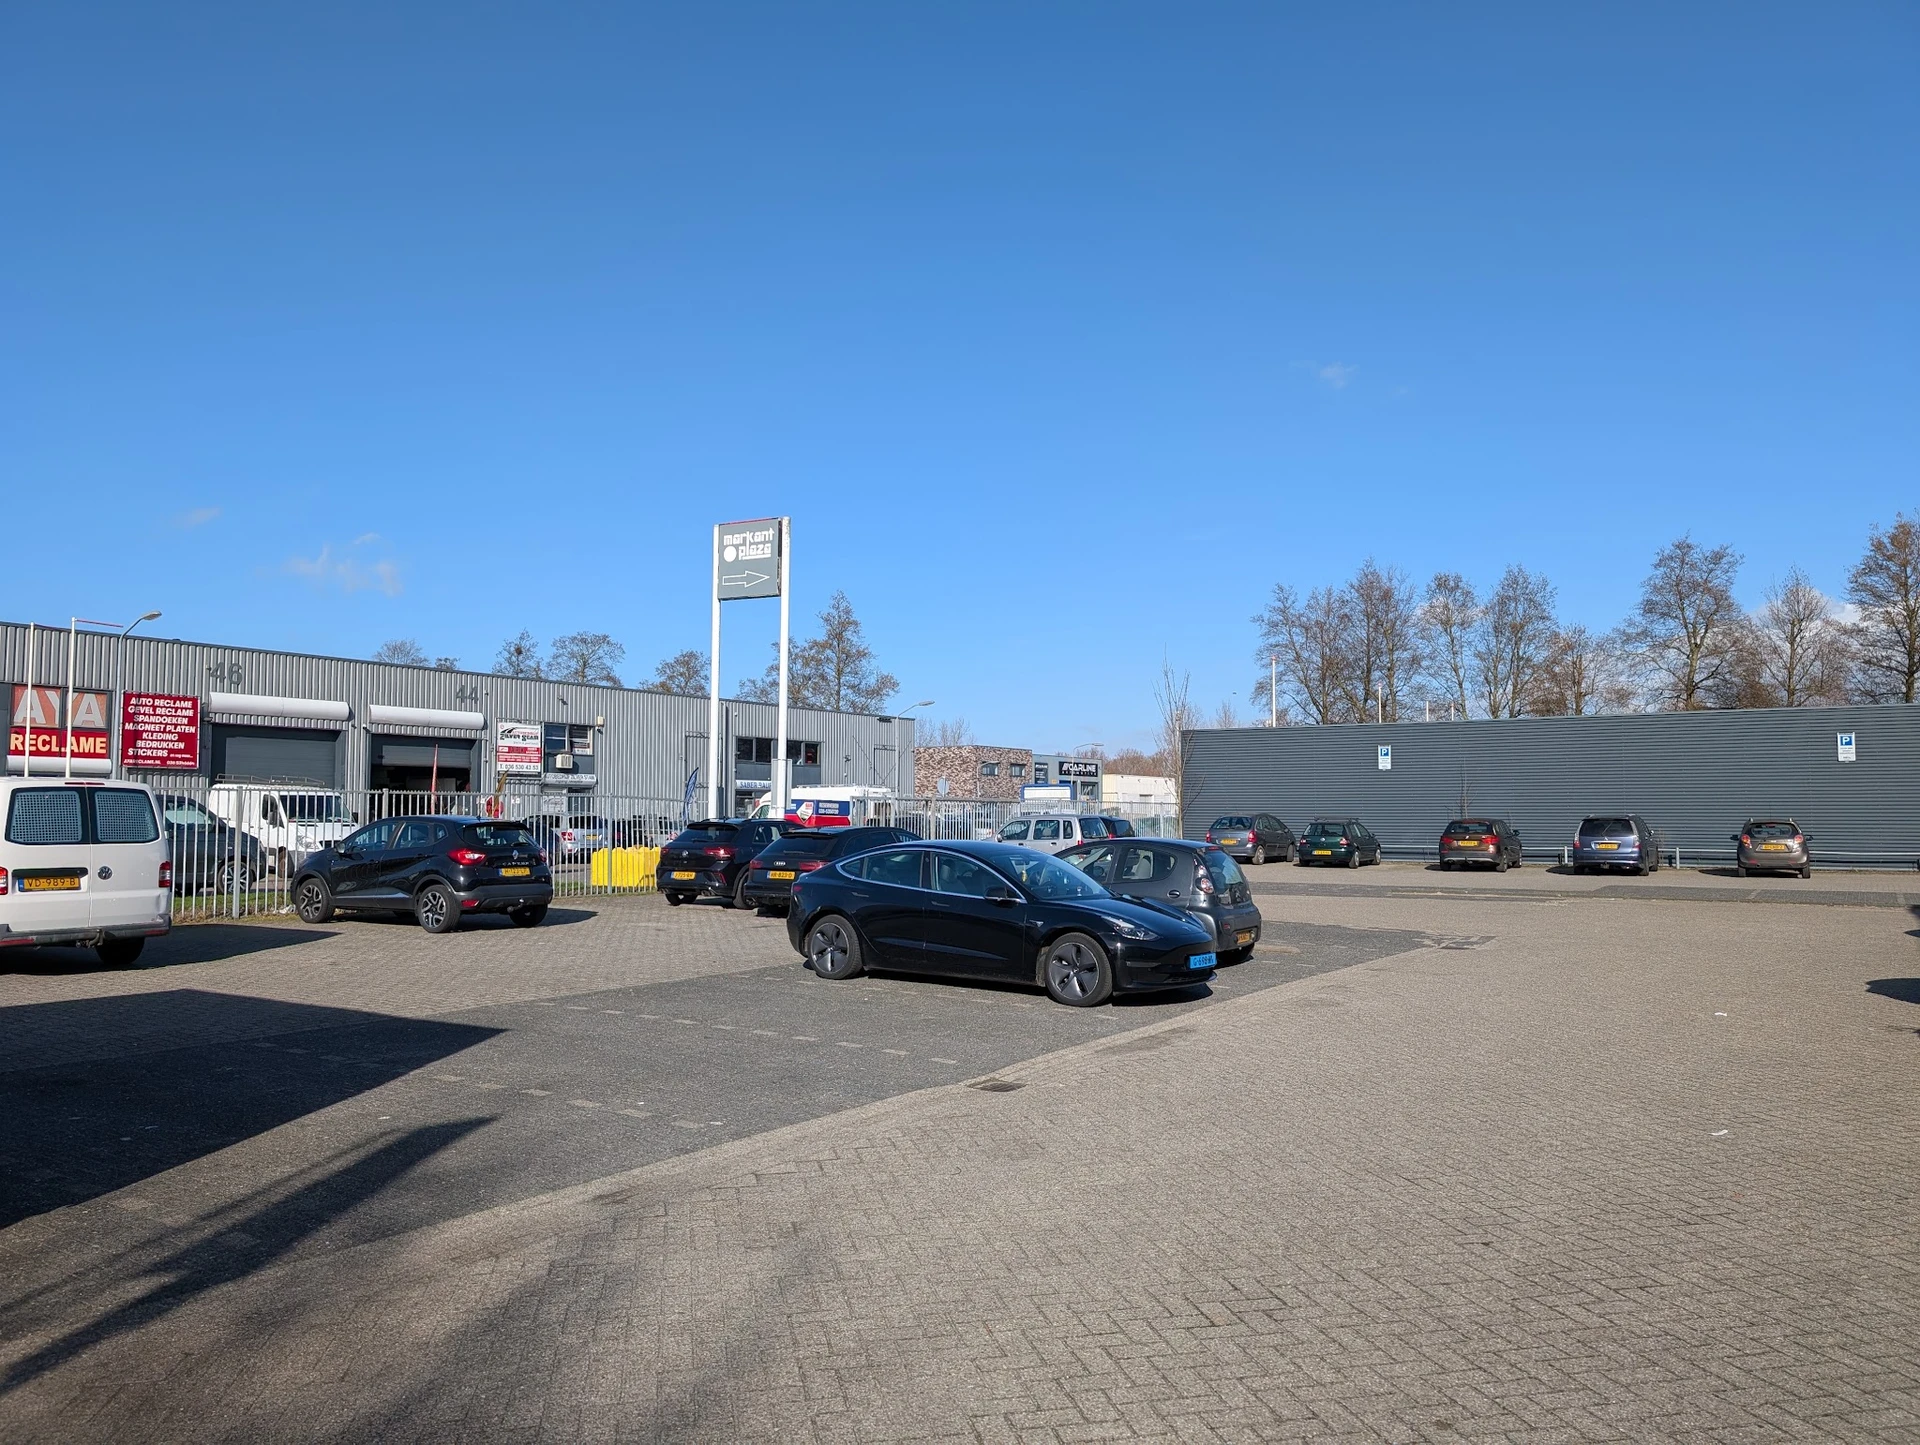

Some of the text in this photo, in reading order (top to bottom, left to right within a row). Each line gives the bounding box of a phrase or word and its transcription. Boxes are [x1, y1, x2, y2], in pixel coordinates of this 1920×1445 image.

[724, 527, 775, 547] markant
[739, 542, 772, 560] plaza
[210, 662, 243, 685] 46
[456, 685, 479, 704] 44
[13, 689, 105, 727] AYA
[130, 697, 193, 708] AUTO RECLAME
[128, 705, 194, 717] GEVEL RECLAME
[133, 714, 188, 724] SPANDOEKEN
[125, 722, 196, 733] MAGNEET PLATEN
[142, 732, 178, 740] KLEDING
[10, 733, 107, 754] RECLAME
[136, 740, 185, 749] BEDRUKKEN
[127, 748, 168, 757] STICKERS
[27, 878, 76, 887] VD-989-B
